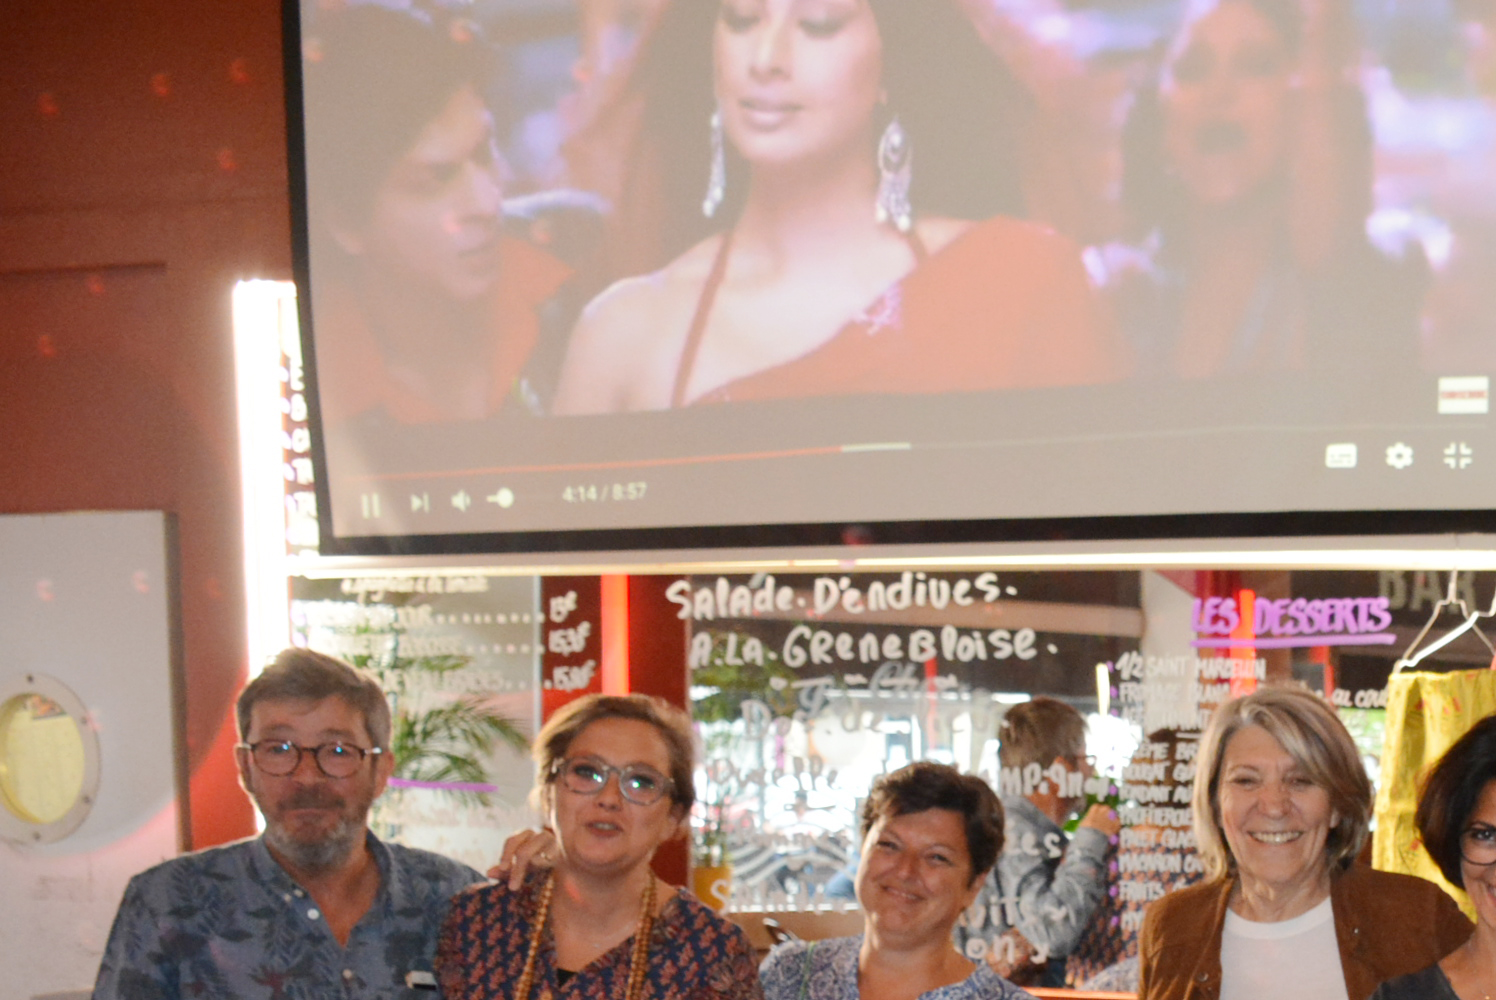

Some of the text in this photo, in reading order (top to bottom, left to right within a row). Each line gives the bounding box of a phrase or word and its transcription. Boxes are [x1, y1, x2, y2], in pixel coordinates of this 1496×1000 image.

[562, 484, 598, 503] 4:14
[612, 480, 647, 501] 8:57
[1190, 595, 1393, 636] LES DESSERTS
